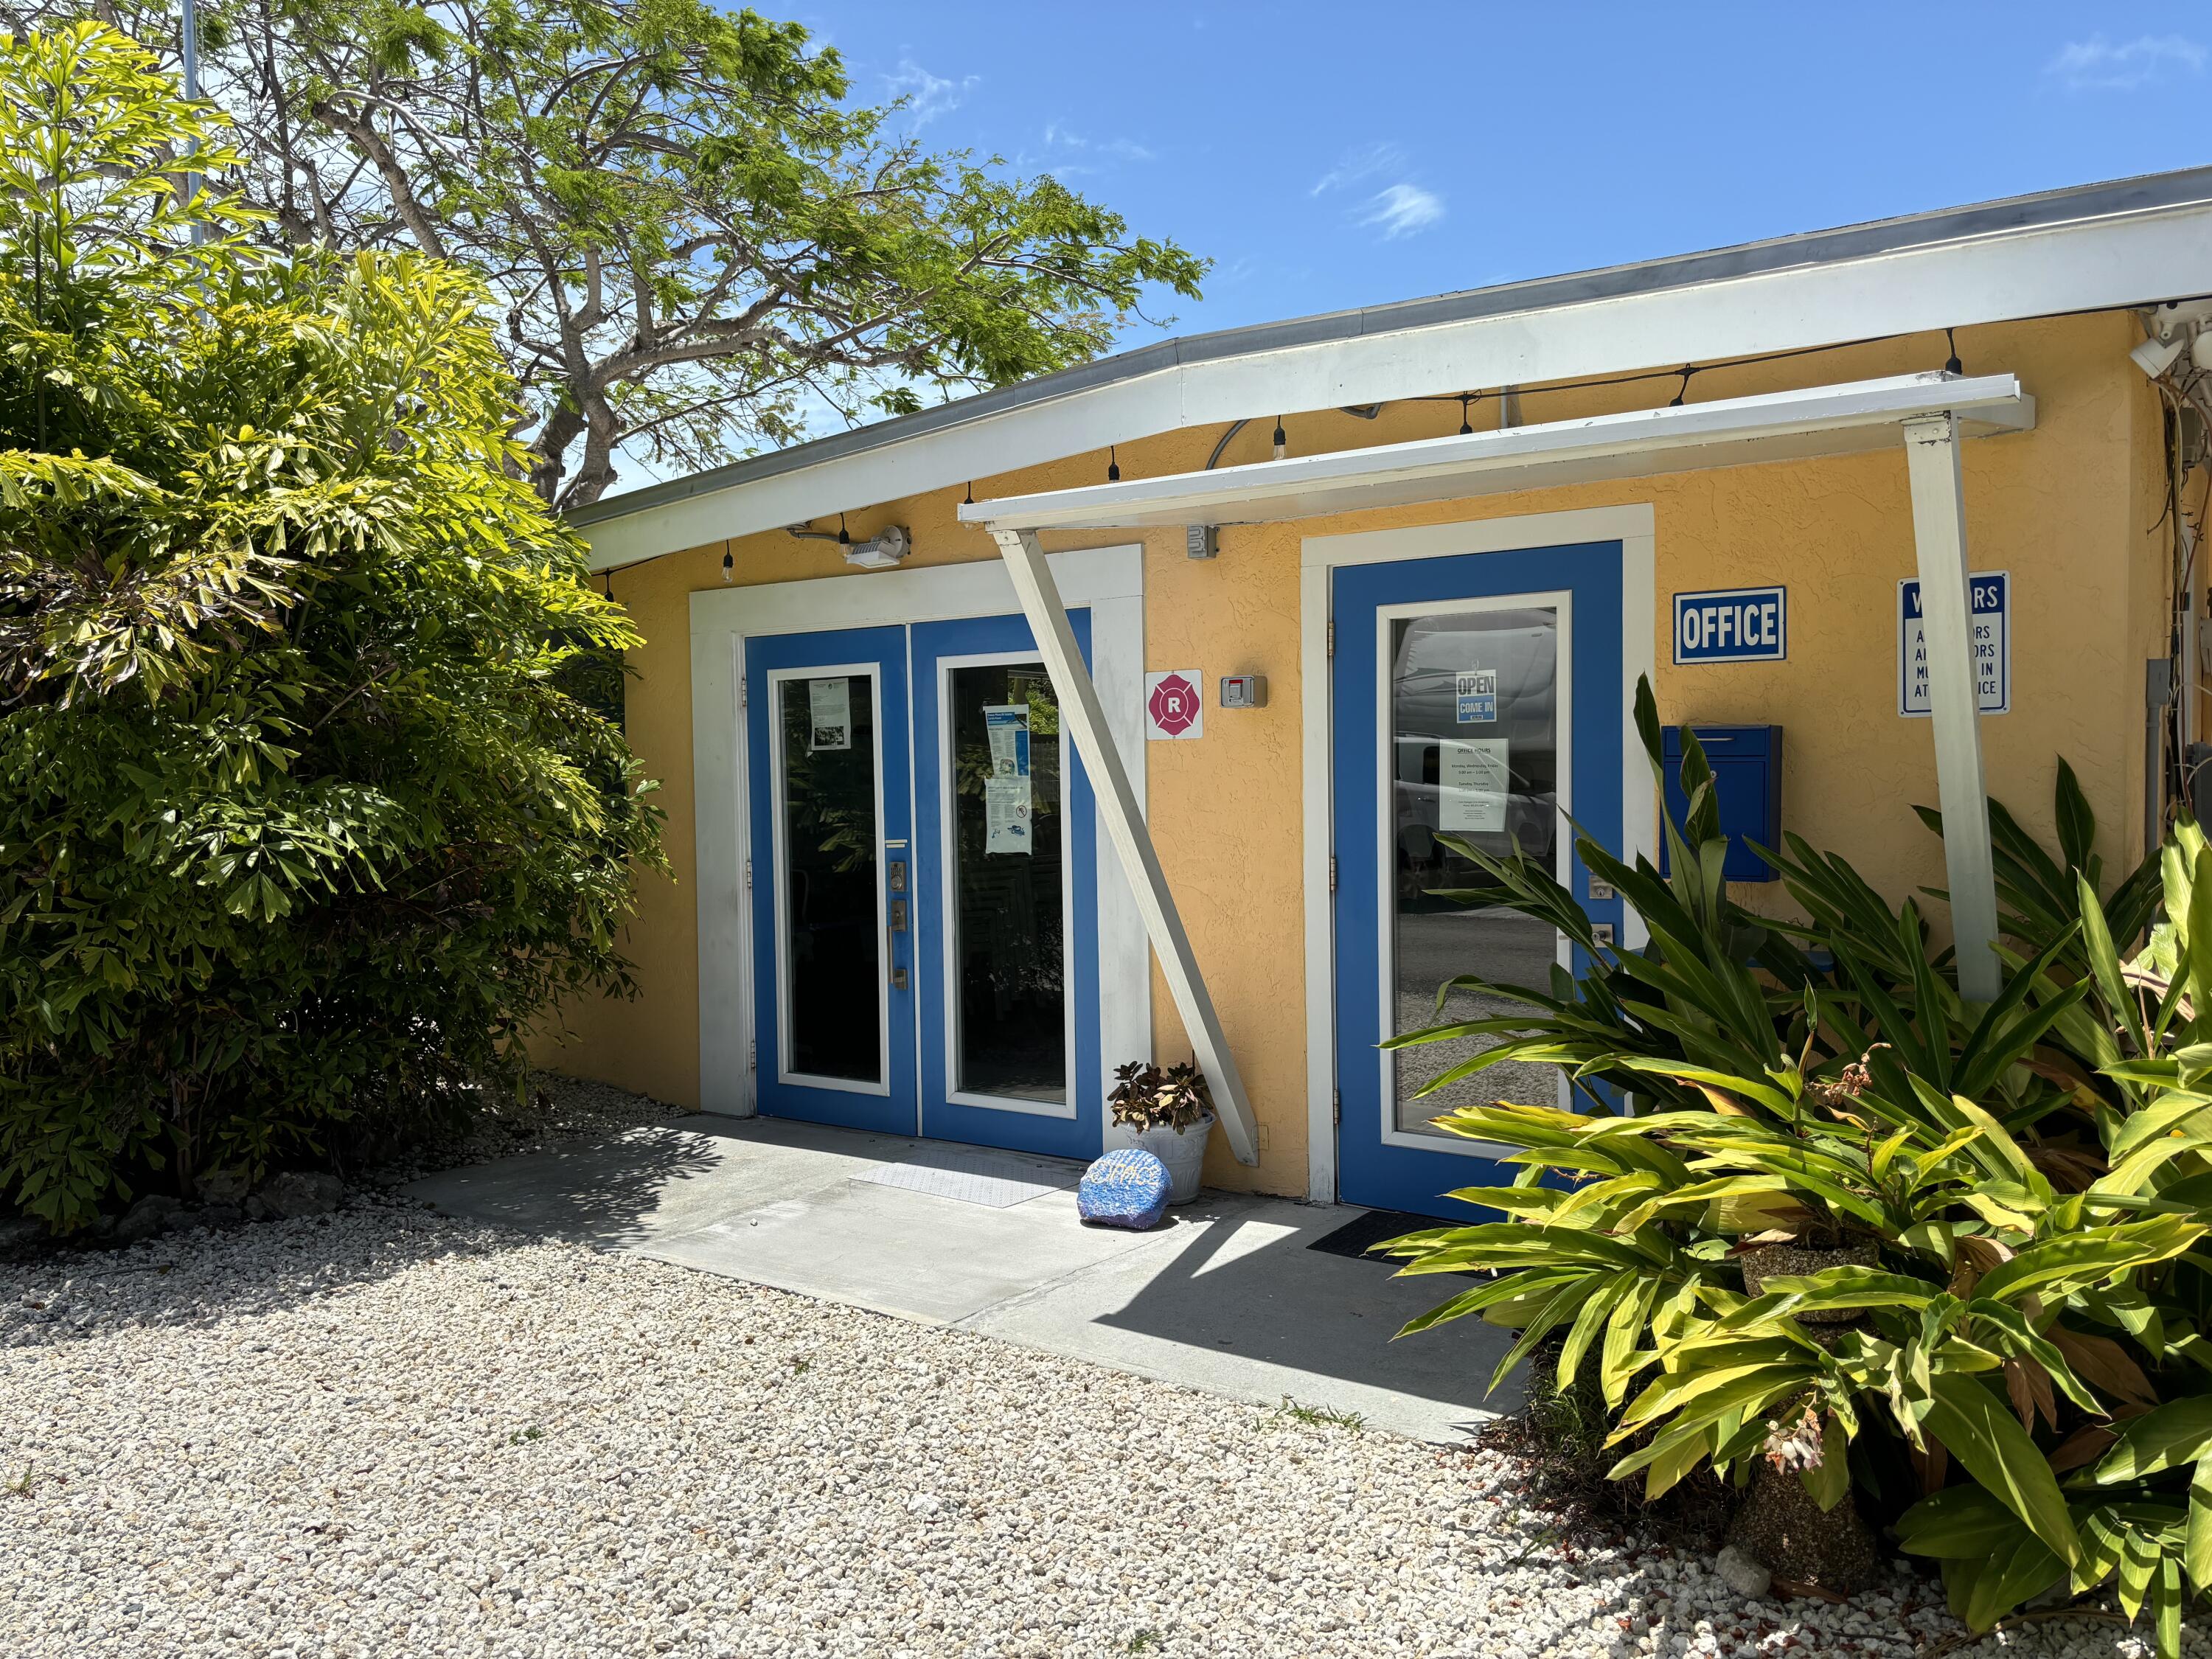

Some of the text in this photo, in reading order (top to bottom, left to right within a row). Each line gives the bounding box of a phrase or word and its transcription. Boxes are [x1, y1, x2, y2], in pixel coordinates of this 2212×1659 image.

[1683, 603, 1776, 650] OFFICE
[1981, 662, 1993, 676] IN
[1458, 676, 1494, 695] OPEN
[1167, 697, 1181, 713] R
[1460, 701, 1493, 714] COME IN
